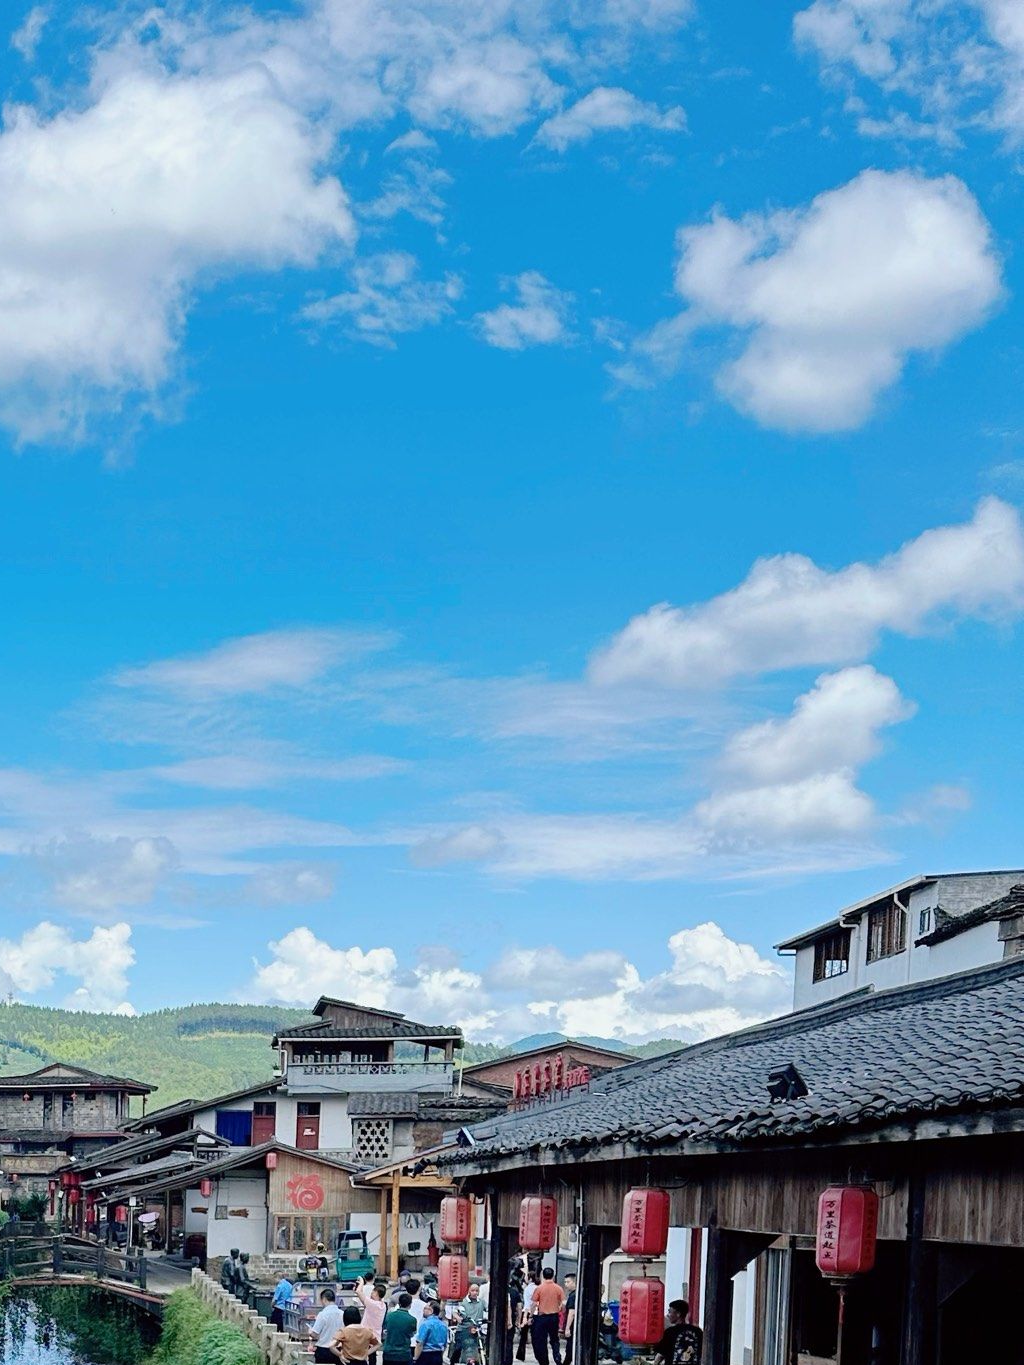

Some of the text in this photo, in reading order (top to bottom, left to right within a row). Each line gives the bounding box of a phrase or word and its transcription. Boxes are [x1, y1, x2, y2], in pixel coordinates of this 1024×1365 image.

[631, 1200, 643, 1244] 万里茶道起点
[822, 1200, 837, 1259] 万里茶道起点
